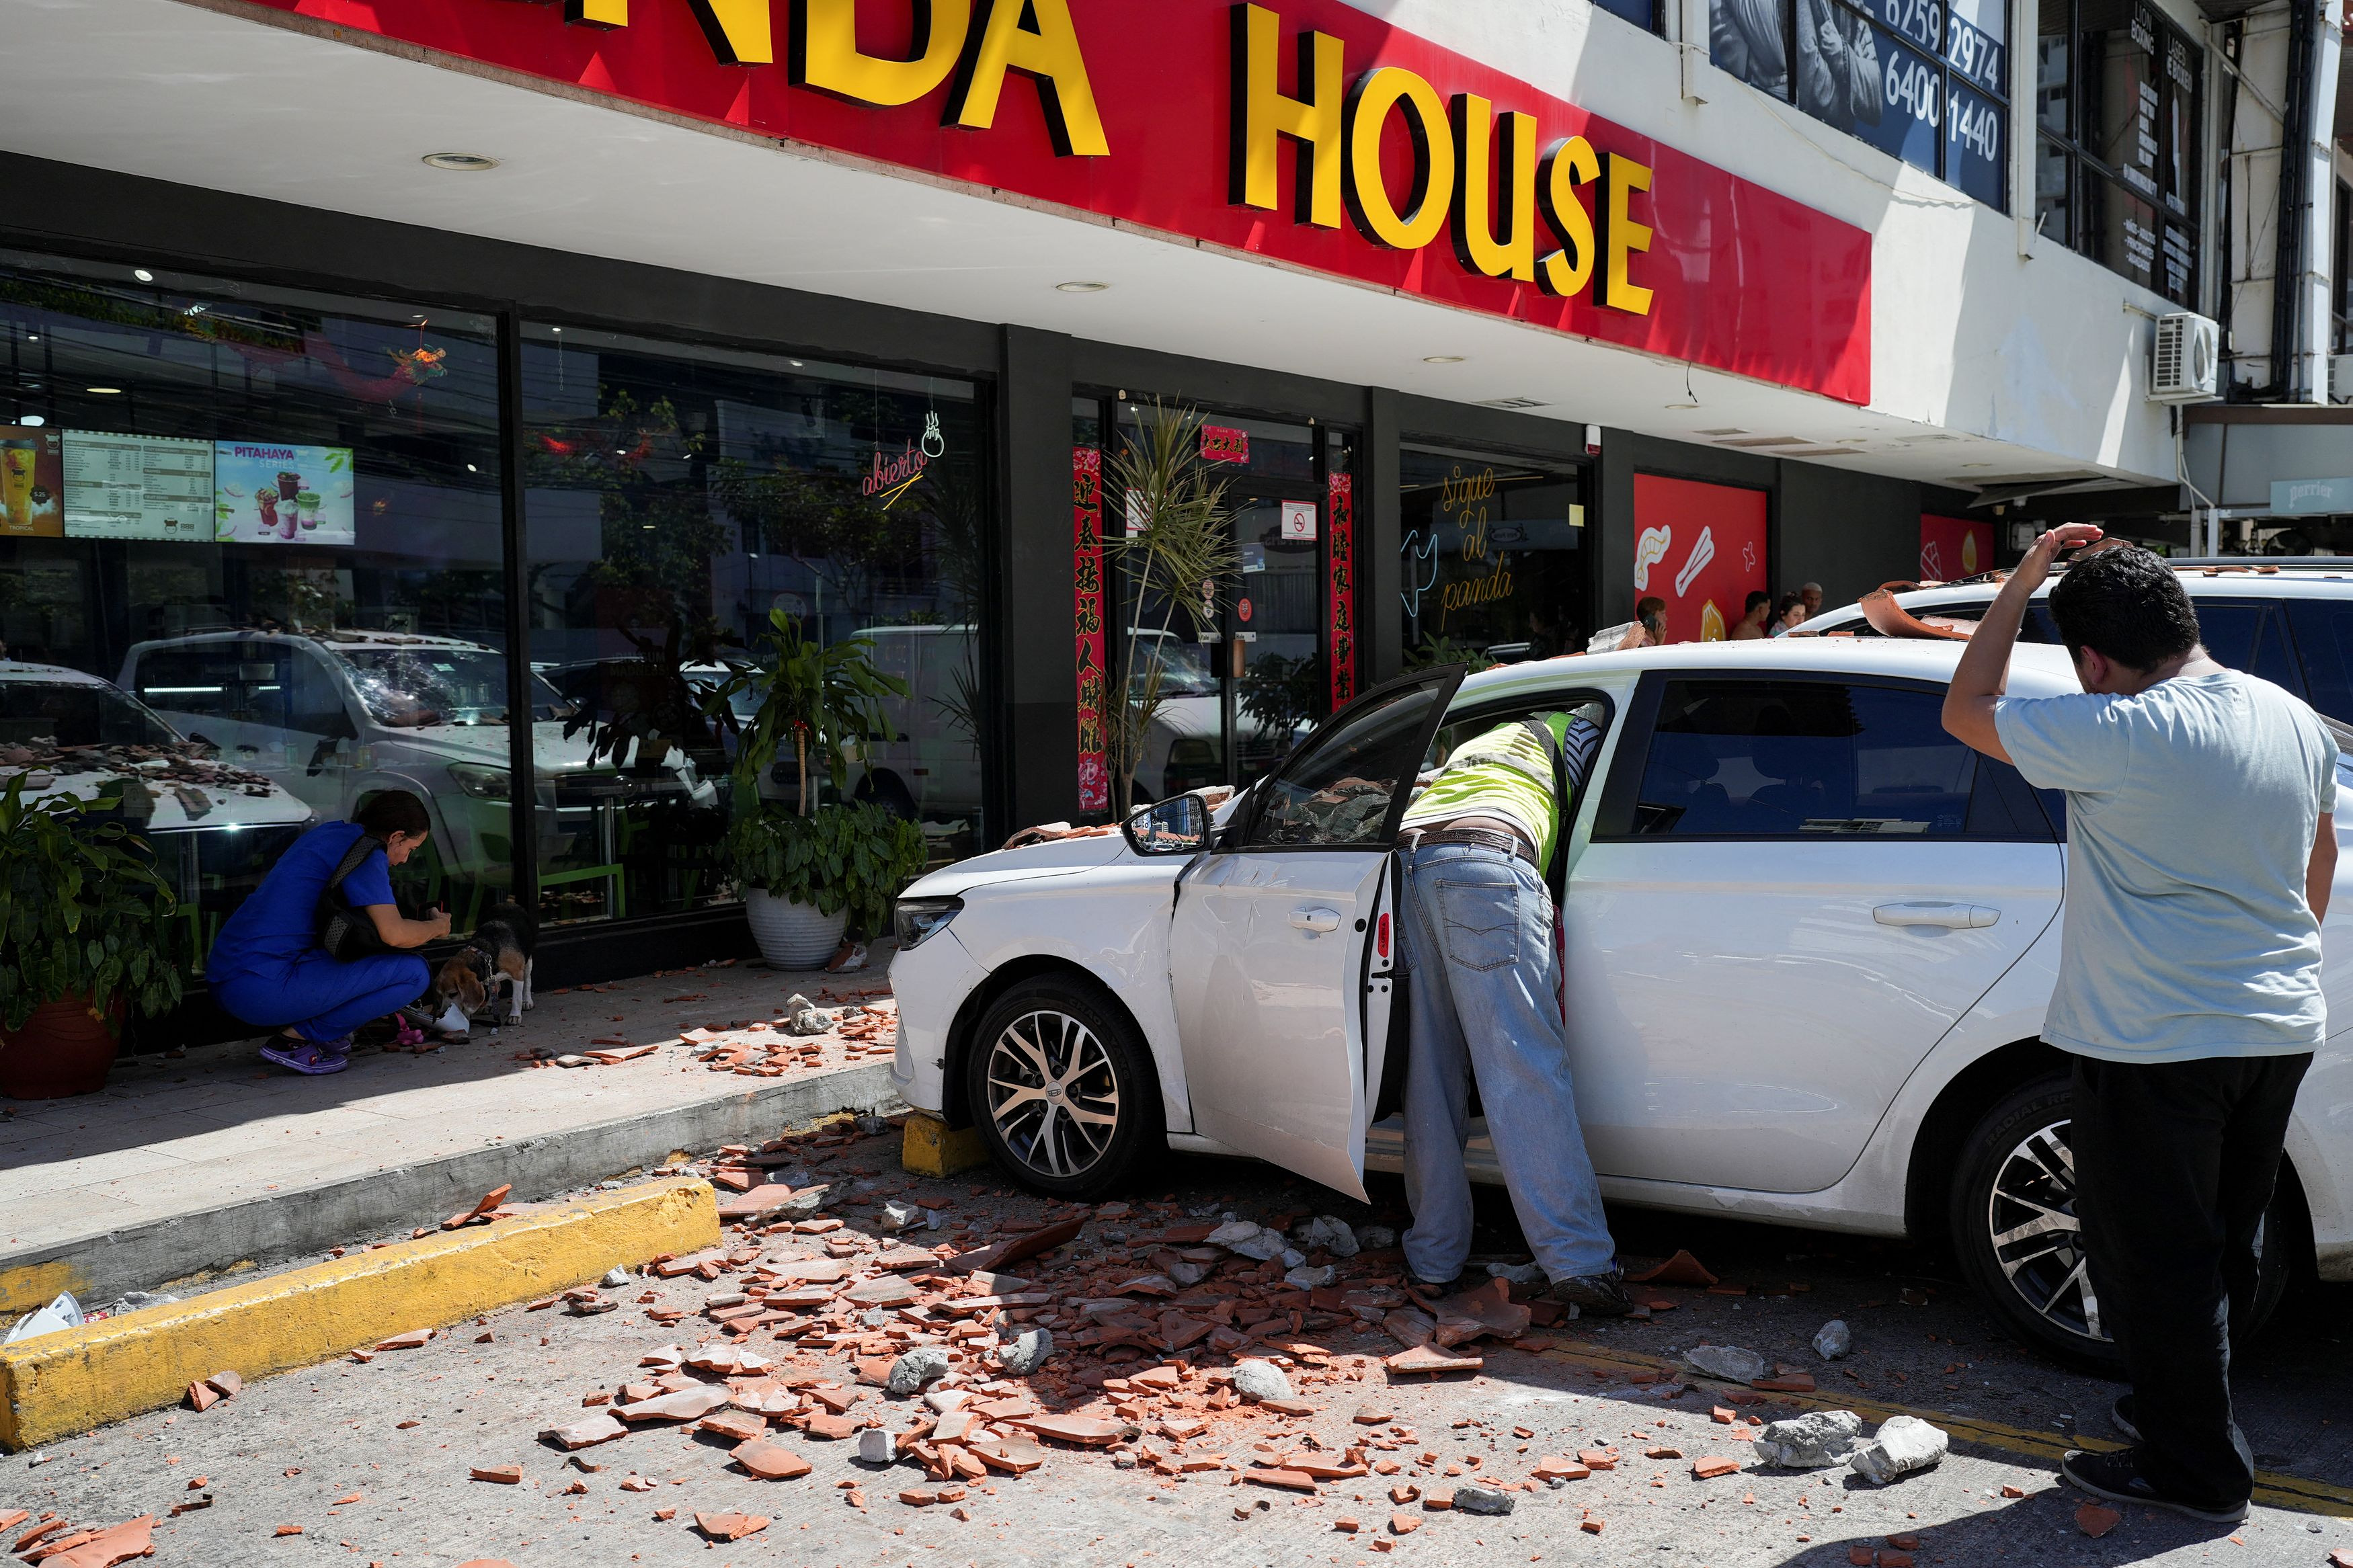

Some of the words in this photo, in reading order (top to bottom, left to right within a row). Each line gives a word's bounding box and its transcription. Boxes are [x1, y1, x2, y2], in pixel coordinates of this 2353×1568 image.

[1230, 1, 1654, 316] HOUSE
[235, 446, 294, 460] PITAHAYA
[260, 460, 294, 470] SERIES
[863, 438, 927, 496] abierto
[1441, 466, 1496, 528] sigue
[1463, 506, 1487, 562] al
[1441, 550, 1513, 632] panda
